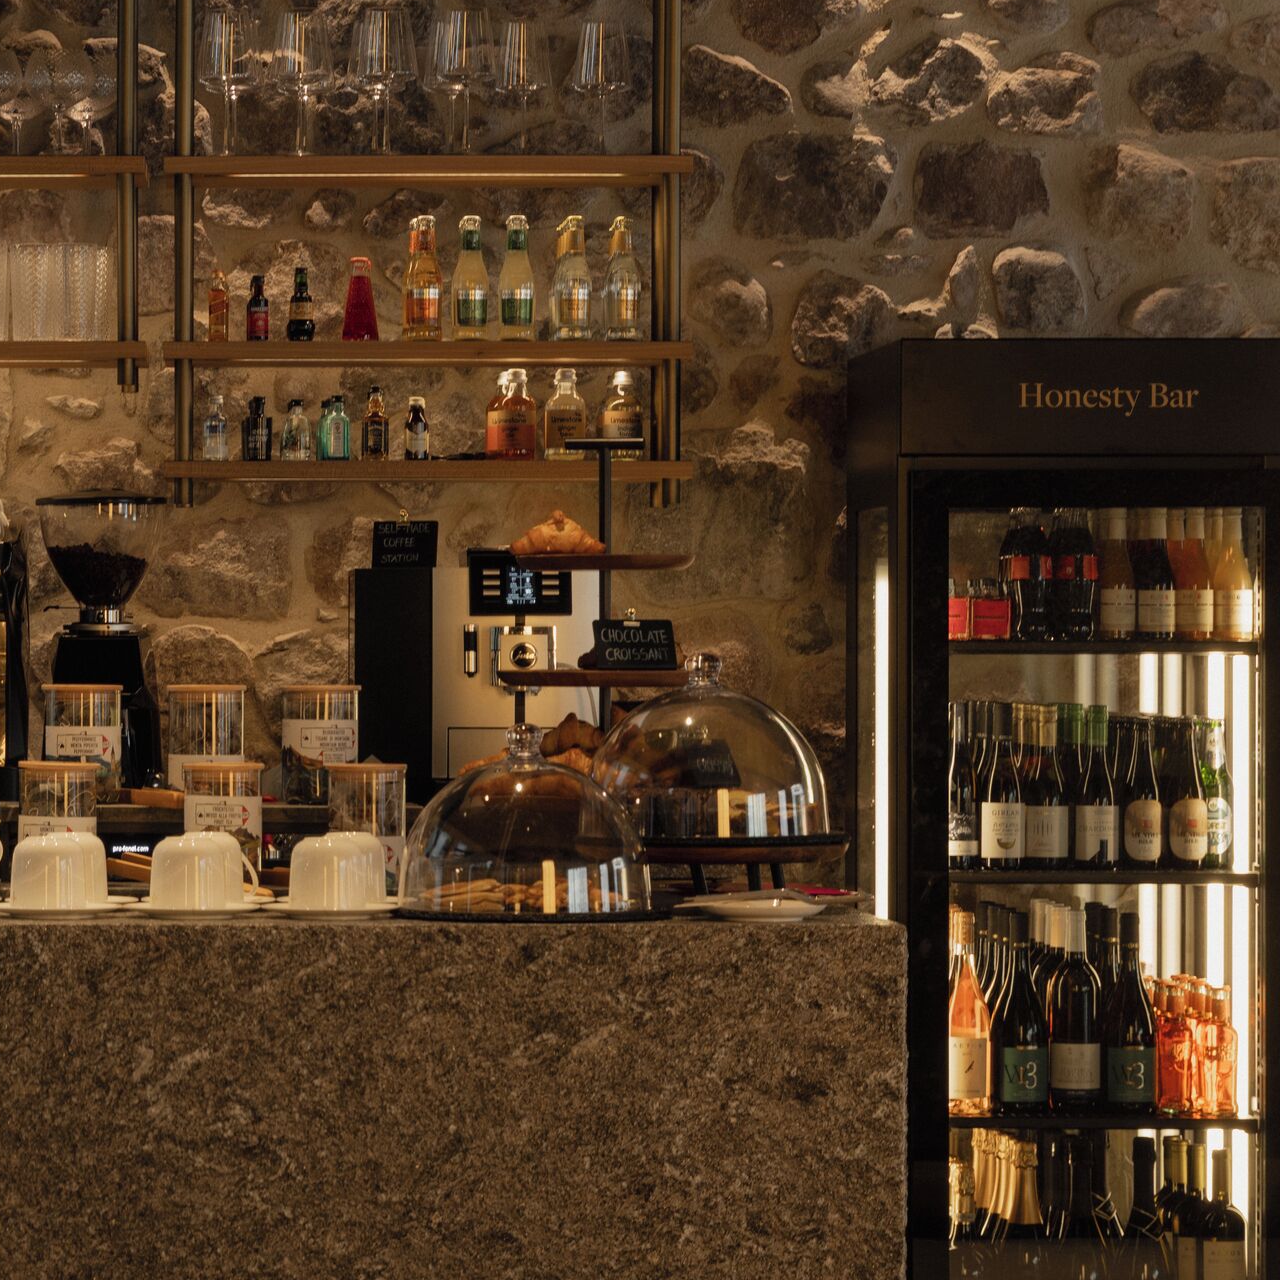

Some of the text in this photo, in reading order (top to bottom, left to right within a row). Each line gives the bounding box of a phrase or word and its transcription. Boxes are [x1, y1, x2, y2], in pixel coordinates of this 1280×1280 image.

[1018, 382, 1200, 417] Honesty Bar
[383, 536, 417, 548] COFFEE
[381, 553, 419, 563] STATION
[600, 627, 669, 643] CHOCOLATE
[605, 647, 669, 661] CROISSANT
